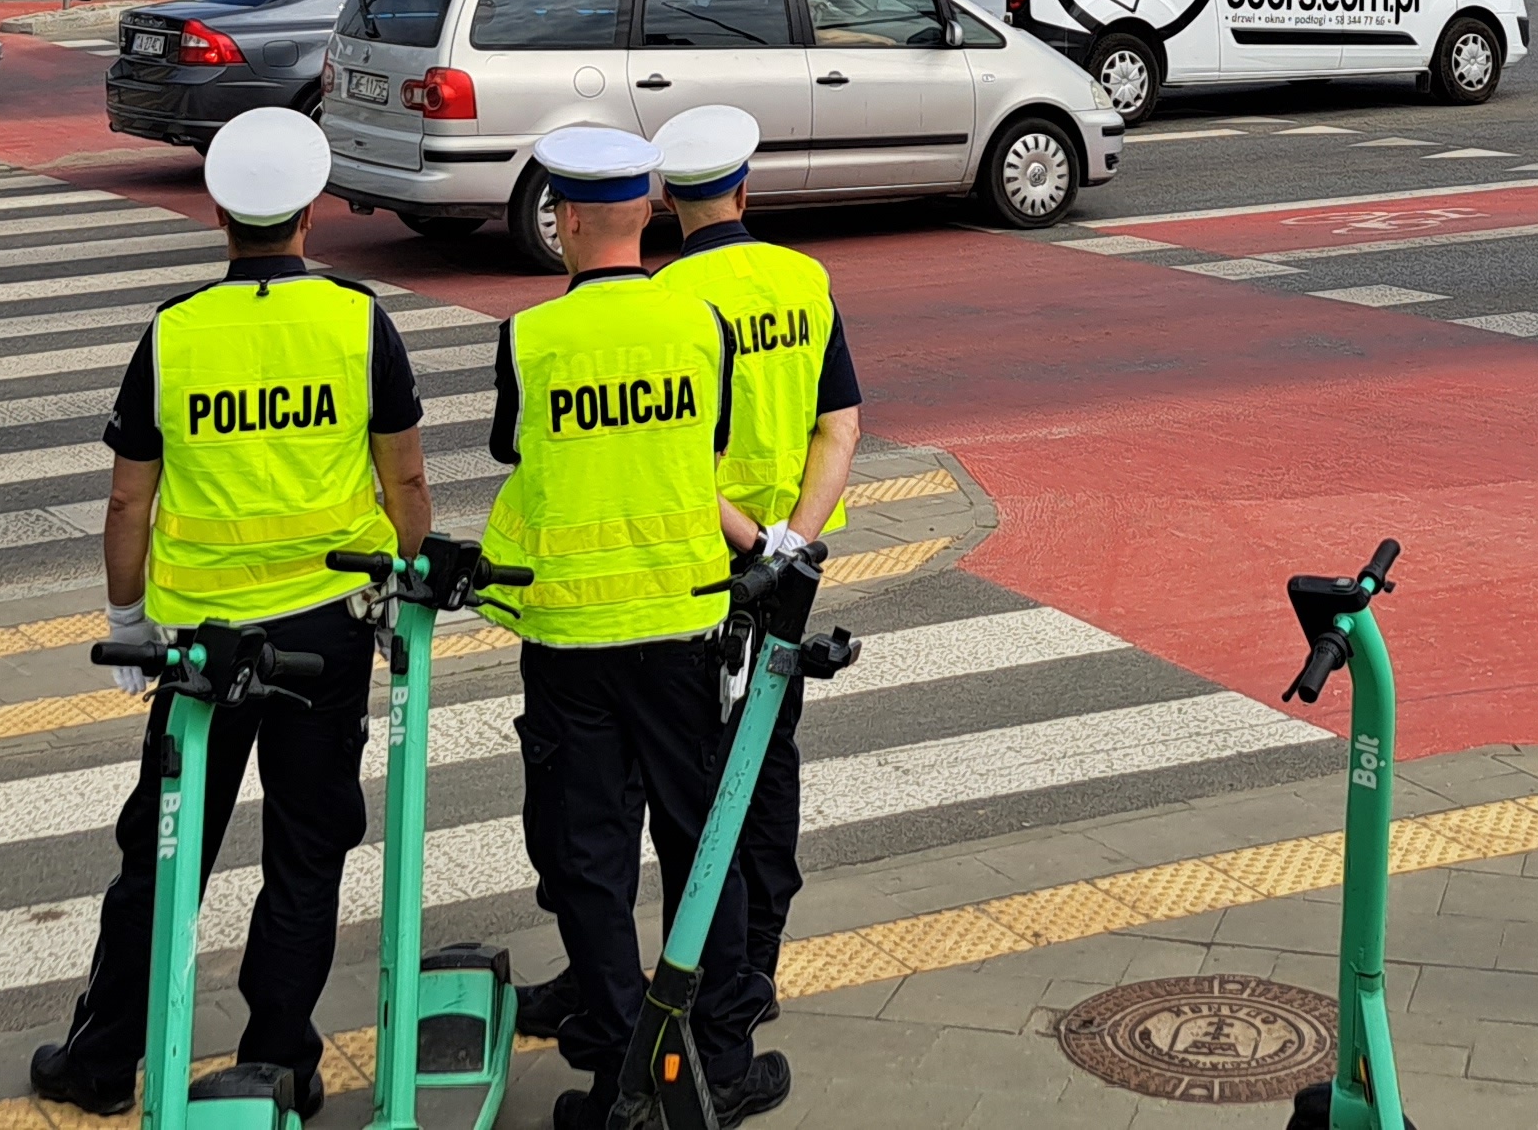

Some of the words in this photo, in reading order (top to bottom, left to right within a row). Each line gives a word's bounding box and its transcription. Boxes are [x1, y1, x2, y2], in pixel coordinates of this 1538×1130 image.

[1232, 13, 1256, 23] drzwi
[1265, 14, 1286, 23] okna
[189, 383, 338, 436] POLICJA
[550, 376, 697, 433] POLICJA
[390, 686, 409, 747] Bolt
[1352, 733, 1386, 790] Bolt
[159, 792, 181, 860] Bolt
